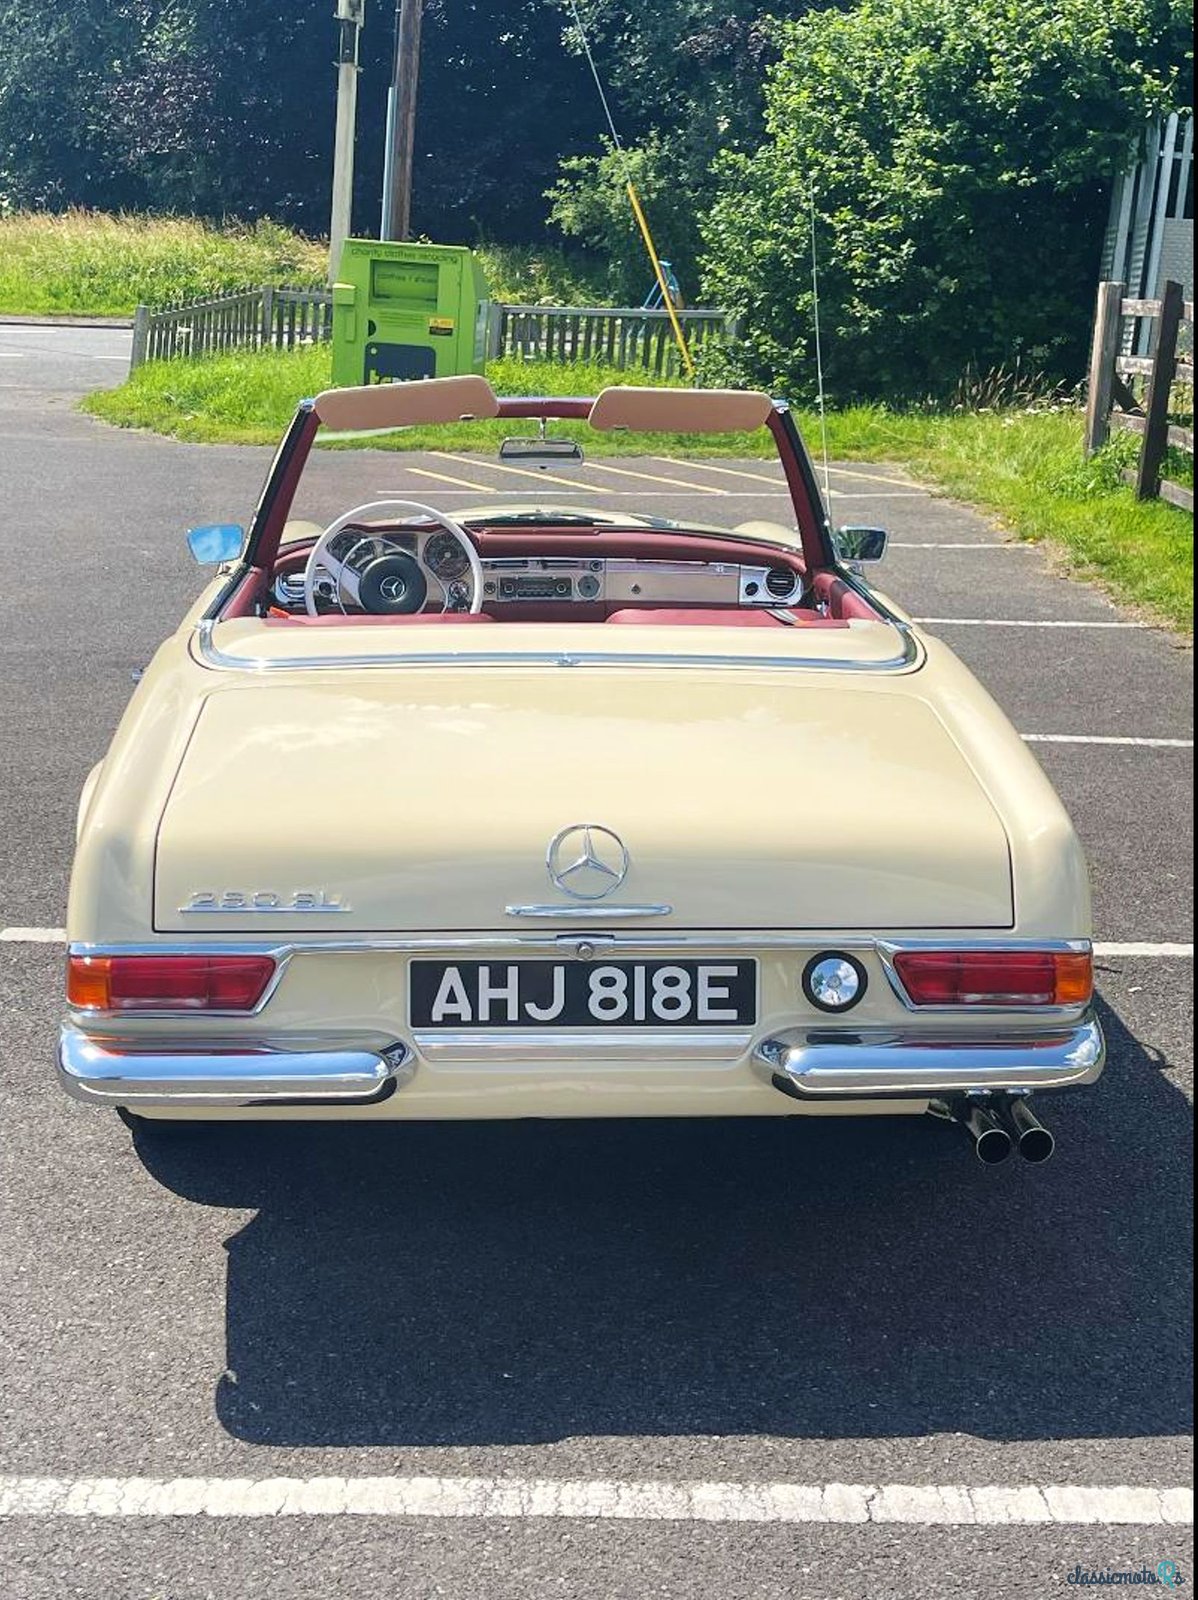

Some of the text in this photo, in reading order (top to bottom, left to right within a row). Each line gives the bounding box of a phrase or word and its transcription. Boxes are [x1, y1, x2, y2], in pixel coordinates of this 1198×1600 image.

[352, 248, 382, 259] charity
[431, 966, 738, 1022] AHJ 818E
